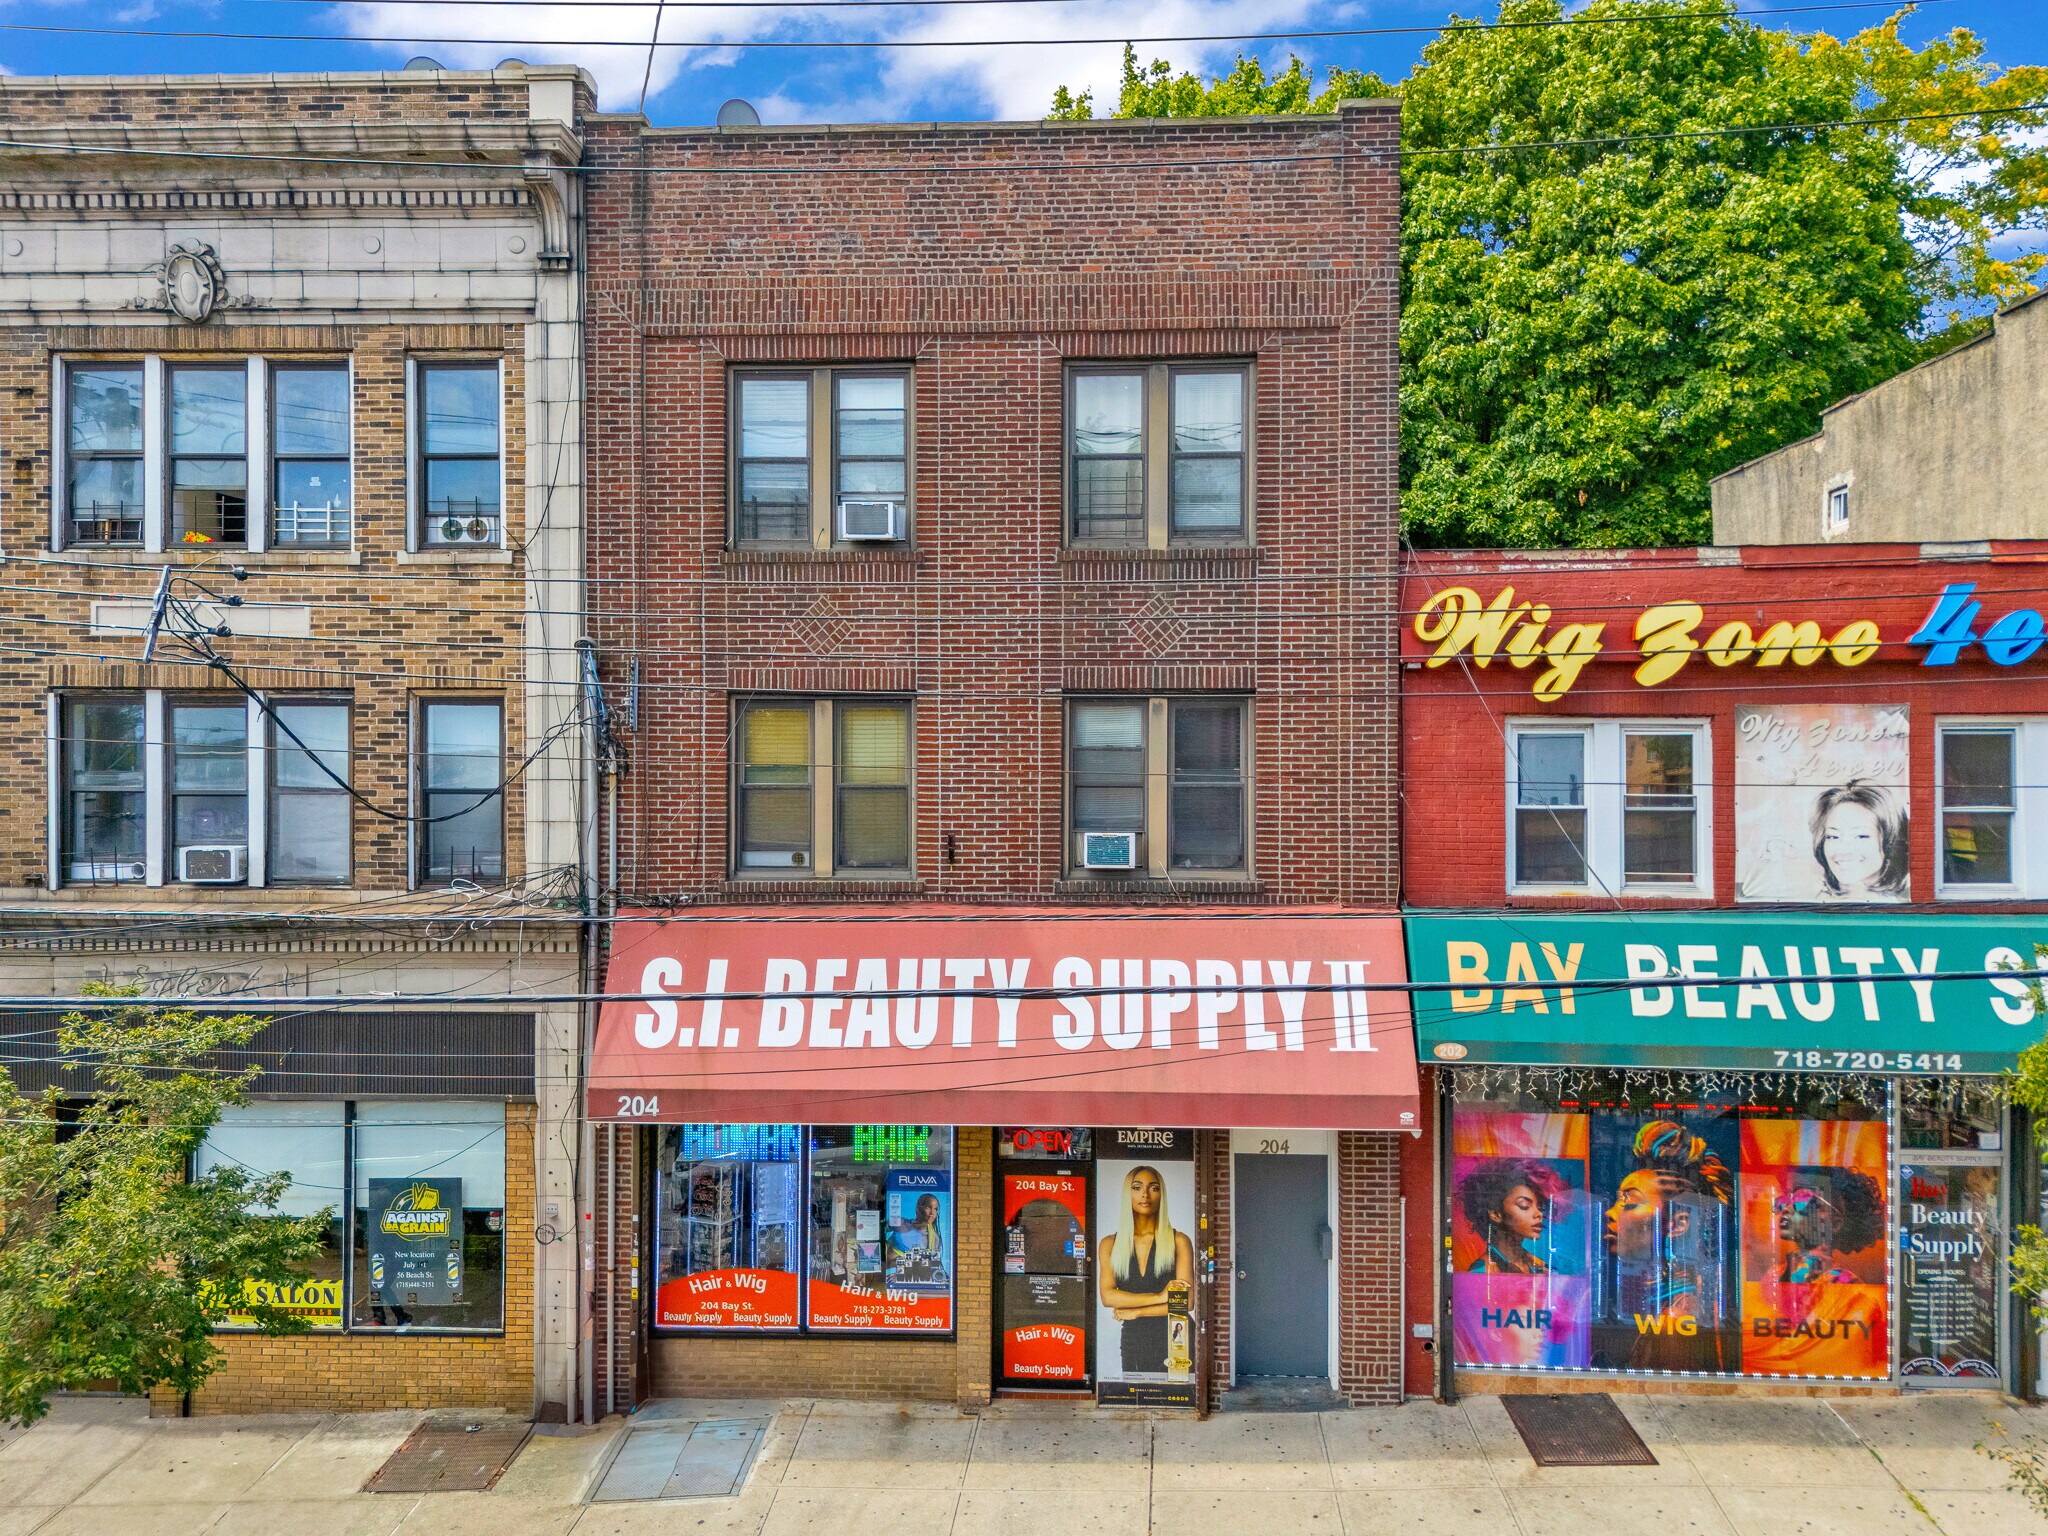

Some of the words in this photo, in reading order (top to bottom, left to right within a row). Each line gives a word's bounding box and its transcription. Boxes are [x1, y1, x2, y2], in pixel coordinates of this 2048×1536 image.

[1414, 586, 1606, 702] Wig
[1634, 600, 1882, 686] Zone
[1741, 714, 1800, 752] Wig
[1447, 941, 1585, 1015] BAY
[1624, 944, 1939, 1022] BEAUTY
[634, 957, 740, 1048] S.I.
[758, 958, 1030, 1048] BEAUTY
[1052, 956, 1311, 1052] SUPPLY
[1439, 1046, 1462, 1057] 202
[1774, 1051, 1962, 1071] 718-720-5414
[617, 1096, 659, 1117] 204
[1014, 1130, 1071, 1152] OPEN
[1260, 1140, 1290, 1154] 204
[899, 1176, 937, 1184] RUWA
[1016, 1181, 1035, 1190] 204
[1039, 1182, 1059, 1192] Bay
[1062, 1182, 1075, 1191] St.
[386, 1213, 447, 1223] AGAINST
[1911, 1204, 1987, 1232] Beauty
[399, 1222, 445, 1233] GRAIN
[1910, 1233, 1985, 1262] Supply
[403, 1261, 416, 1269] July
[688, 1275, 722, 1294] Hair
[734, 1273, 767, 1293] Wig
[256, 1286, 336, 1304] SALON
[840, 1280, 873, 1297] Hair
[876, 1291, 882, 1299] &
[887, 1289, 918, 1305] Wig
[701, 1302, 718, 1310] 204
[721, 1302, 739, 1311] Bay
[742, 1302, 754, 1310] St.
[854, 1306, 906, 1314] 718-273-3781
[664, 1312, 692, 1322] Beauty
[734, 1313, 762, 1324] Beauty
[764, 1313, 792, 1324] Supply
[814, 1314, 842, 1325] Beauty
[844, 1314, 872, 1326] Supply
[884, 1315, 912, 1326] Beauty
[915, 1316, 943, 1327] Supply
[1482, 1308, 1553, 1329] HAIR
[1634, 1313, 1698, 1336] WIG
[1753, 1317, 1876, 1340] BEAUTY
[1015, 1327, 1041, 1342] Hair
[1050, 1327, 1075, 1344] Wig
[1014, 1363, 1043, 1376] Beauty
[1045, 1364, 1073, 1376] Supply
